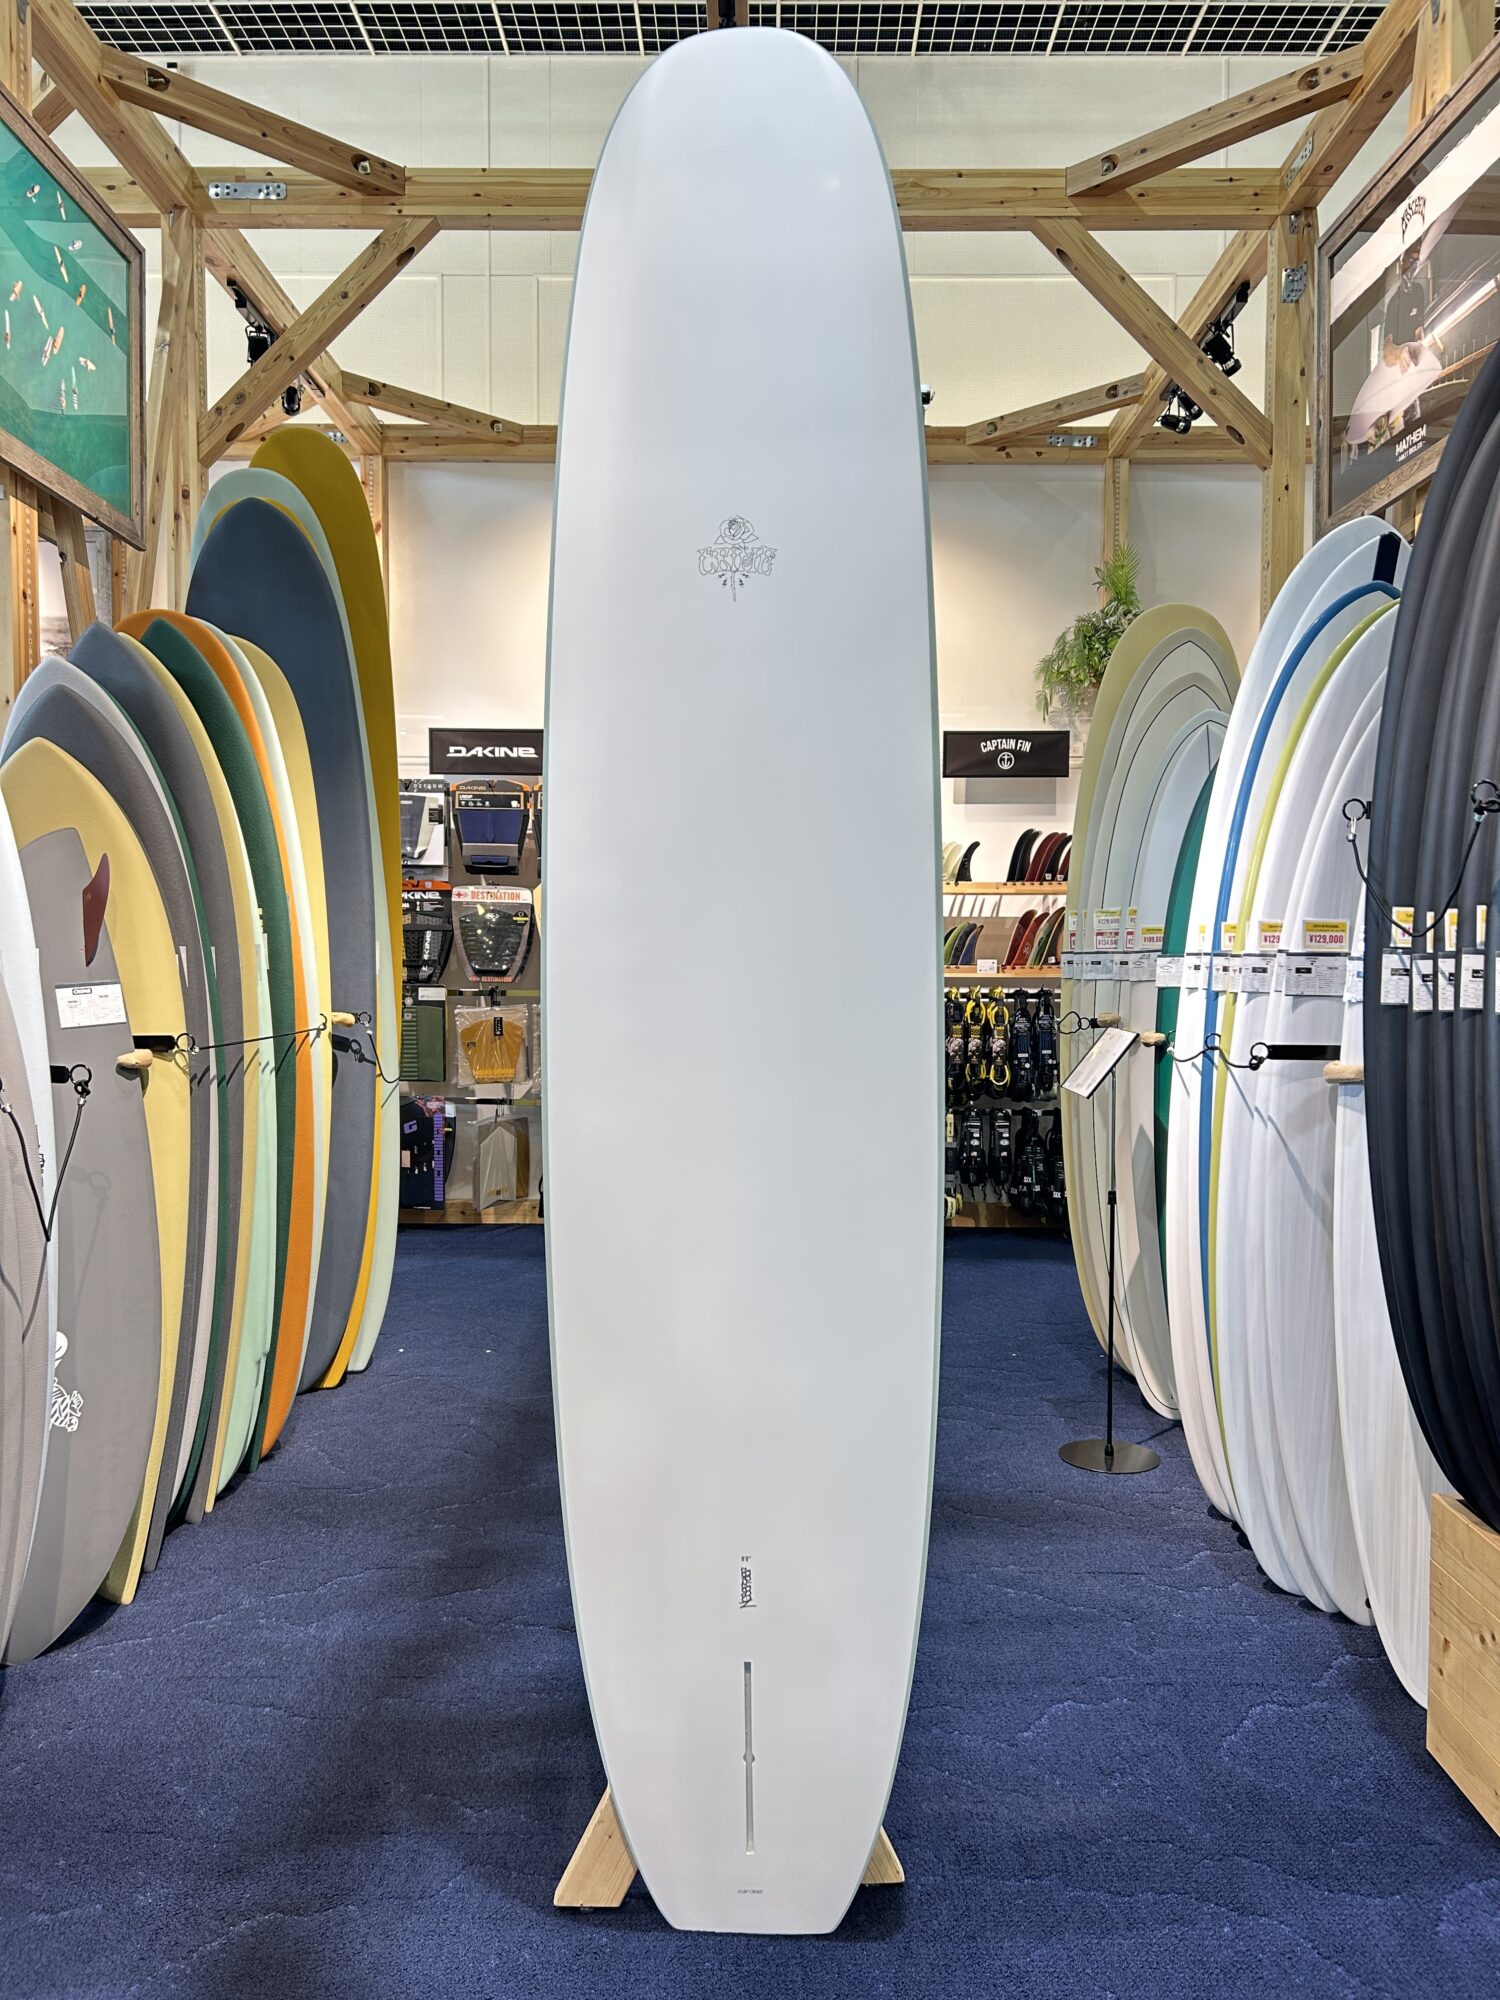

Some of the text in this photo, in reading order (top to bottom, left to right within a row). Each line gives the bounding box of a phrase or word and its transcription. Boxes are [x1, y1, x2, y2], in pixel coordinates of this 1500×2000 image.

[1395, 423, 1427, 456] MAYHEM
[697, 545, 778, 576] CRIME
[980, 738, 1032, 753] CAPTAIN FIN
[446, 746, 539, 758] DAKINE
[402, 891, 442, 900] KINE
[470, 891, 521, 900] DESTINATION
[1309, 934, 1344, 944] ¥129,000
